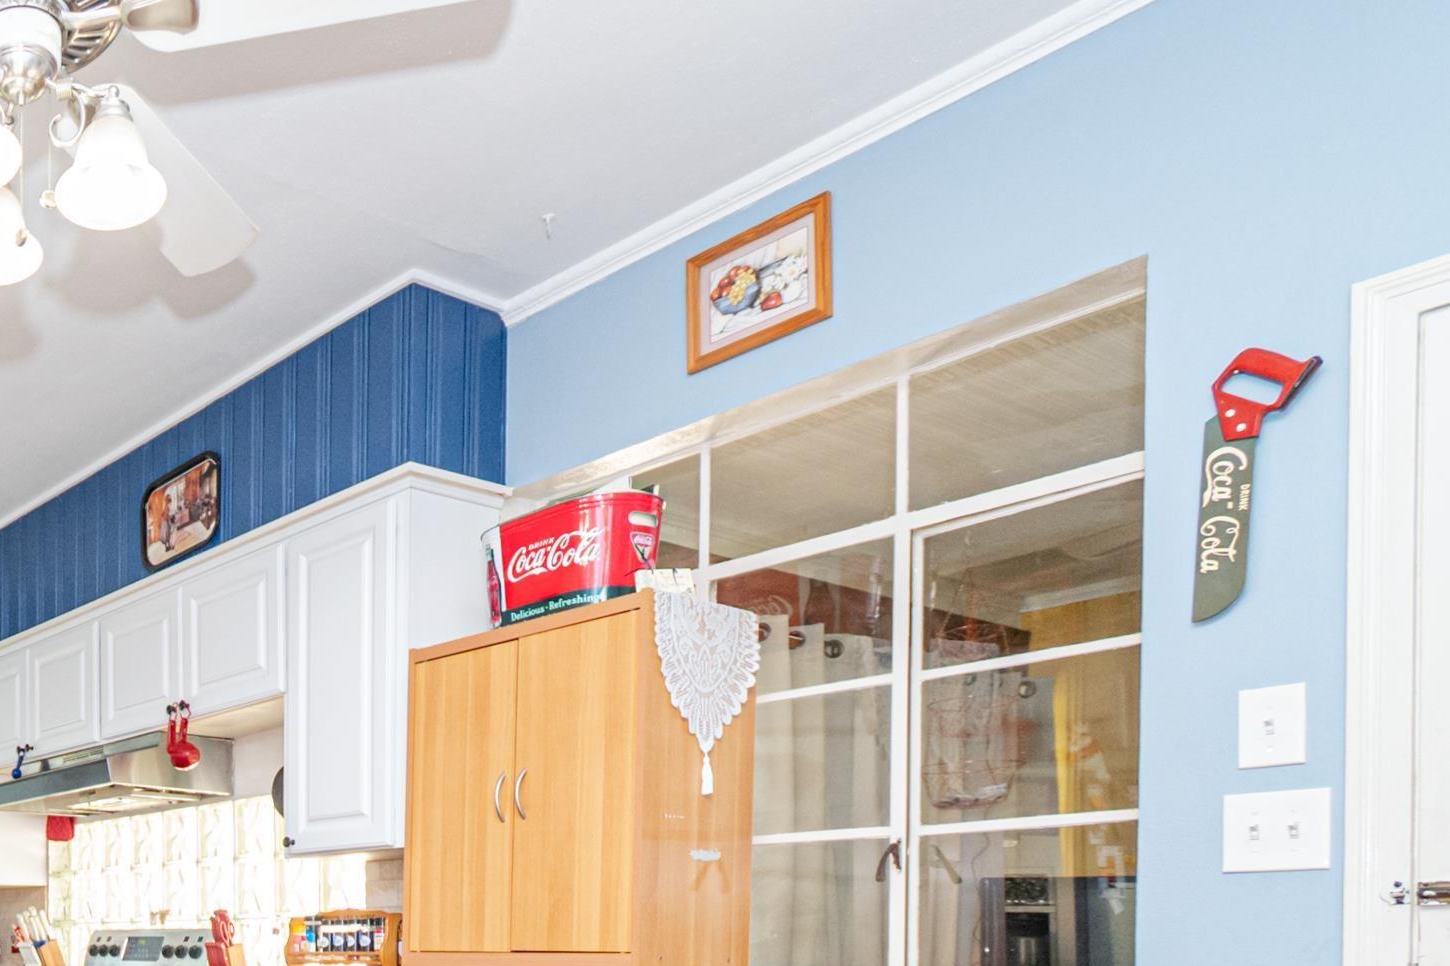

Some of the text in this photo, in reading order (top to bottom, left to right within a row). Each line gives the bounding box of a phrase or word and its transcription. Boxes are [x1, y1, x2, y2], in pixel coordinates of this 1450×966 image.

[1238, 483, 1251, 511] DRINK
[507, 526, 606, 583] Coca-Cola
[527, 536, 554, 551] DRINK
[510, 592, 605, 622] Delicious Refreshing
